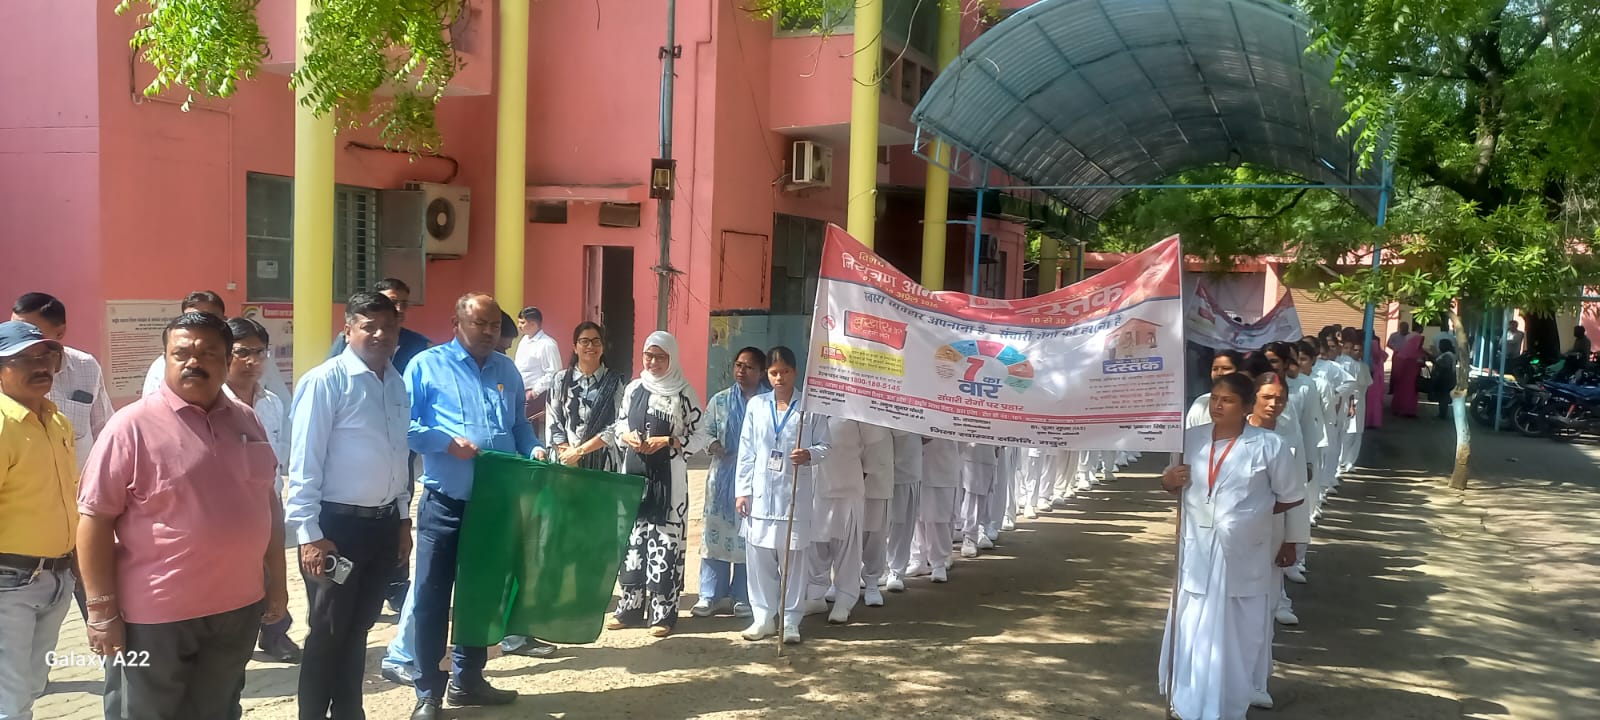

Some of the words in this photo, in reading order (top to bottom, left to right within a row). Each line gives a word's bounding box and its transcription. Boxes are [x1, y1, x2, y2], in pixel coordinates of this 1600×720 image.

[963, 356, 985, 382] 7
[982, 375, 1000, 385] का
[1104, 362, 1161, 373] दस्तक
[850, 376, 901, 392] 1800-180-5145
[957, 379, 1003, 399] वार
[937, 393, 962, 404] संचारी
[964, 398, 985, 408] रोगों
[986, 401, 999, 409] पर
[1000, 403, 1025, 411] प्रहार
